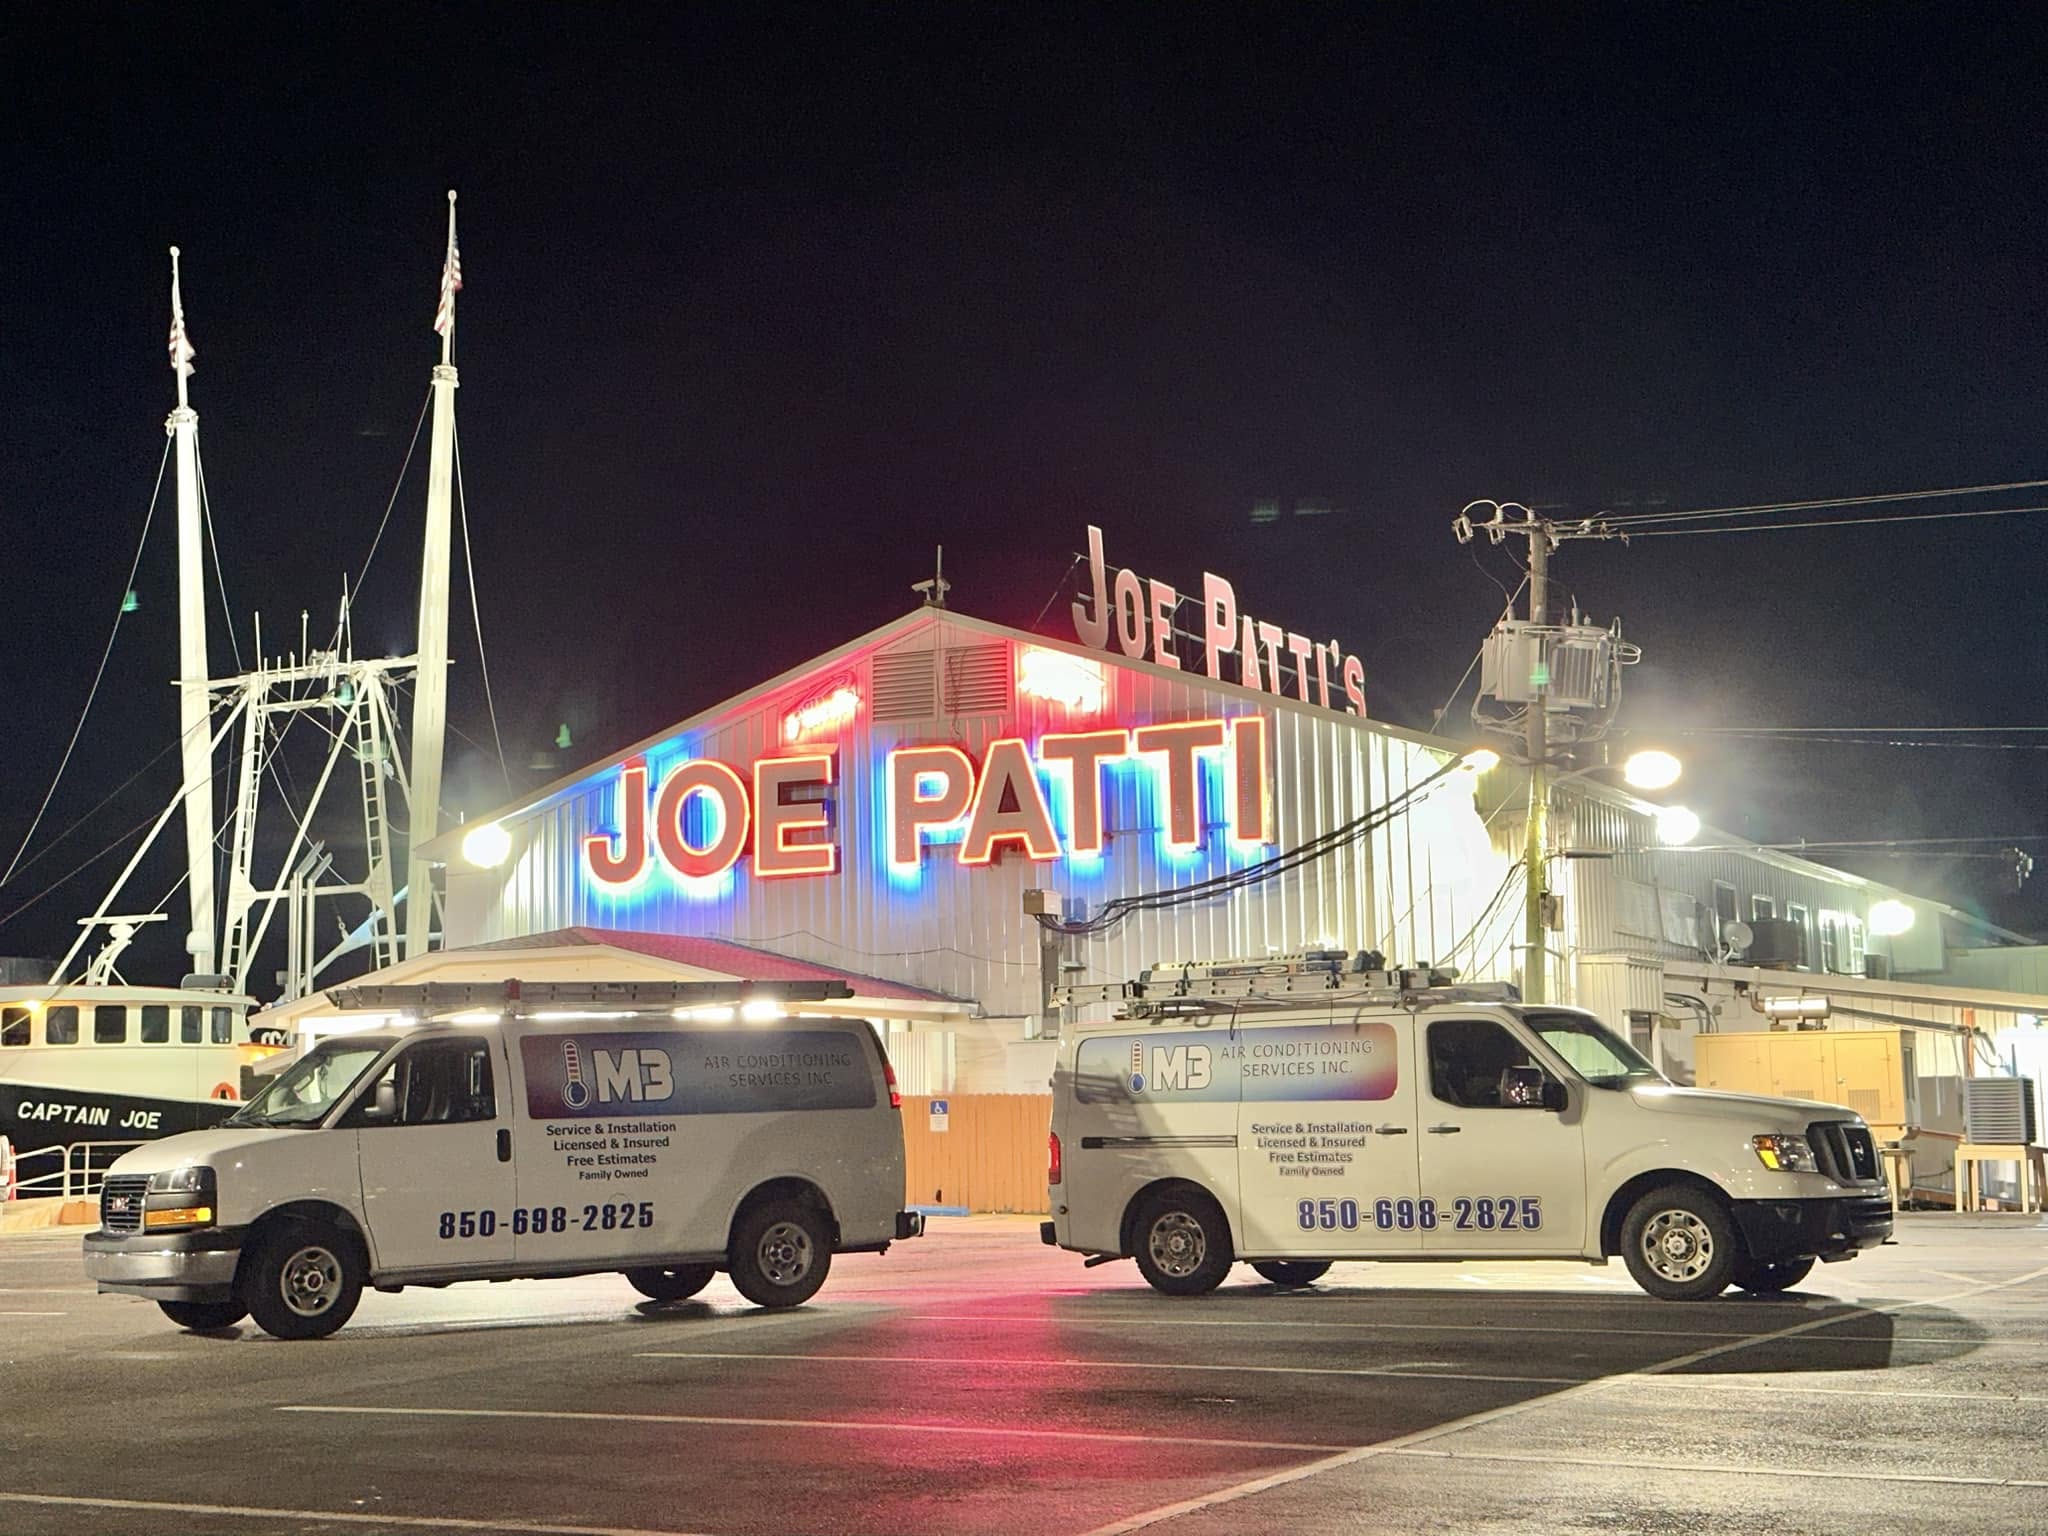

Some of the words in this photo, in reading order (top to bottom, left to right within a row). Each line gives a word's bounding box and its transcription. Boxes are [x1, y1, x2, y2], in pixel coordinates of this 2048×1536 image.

[1072, 525, 1181, 671] JOE
[1203, 571, 1368, 718] PATTI'S
[582, 754, 838, 887] JOE
[886, 715, 1269, 868] PATTI
[1221, 1046, 1247, 1059] AIR
[1252, 1040, 1373, 1058] CONDITIONING
[704, 1055, 730, 1070] AIR
[736, 1052, 852, 1069] CONDITIONING
[1242, 1062, 1315, 1078] SERVICES
[1321, 1060, 1354, 1075] INC.
[729, 1072, 801, 1088] SERVICES
[17, 1101, 110, 1126] CAPTAIN
[120, 1110, 162, 1130] JOE
[546, 1124, 592, 1136] Service
[594, 1124, 605, 1135] &
[607, 1121, 677, 1134] Installation
[1251, 1123, 1293, 1134] Service
[1295, 1123, 1303, 1133] &
[1307, 1122, 1373, 1134] Installation
[553, 1139, 607, 1151] Licensed
[610, 1139, 620, 1149] &
[623, 1136, 670, 1149] Insured
[1257, 1138, 1306, 1148] Licensed
[1308, 1138, 1317, 1147] &
[1320, 1137, 1366, 1148] Insured
[566, 1155, 594, 1166] Free
[597, 1153, 657, 1165] Estimates
[1269, 1152, 1294, 1162] Free
[1297, 1152, 1353, 1162] Estimates
[578, 1170, 612, 1181] Family
[614, 1168, 648, 1179] Owned
[1279, 1167, 1309, 1178] Family
[1312, 1166, 1344, 1176] Owned
[439, 1202, 653, 1239] 850-698-2825
[1298, 1197, 1543, 1231] 850-698-2825
